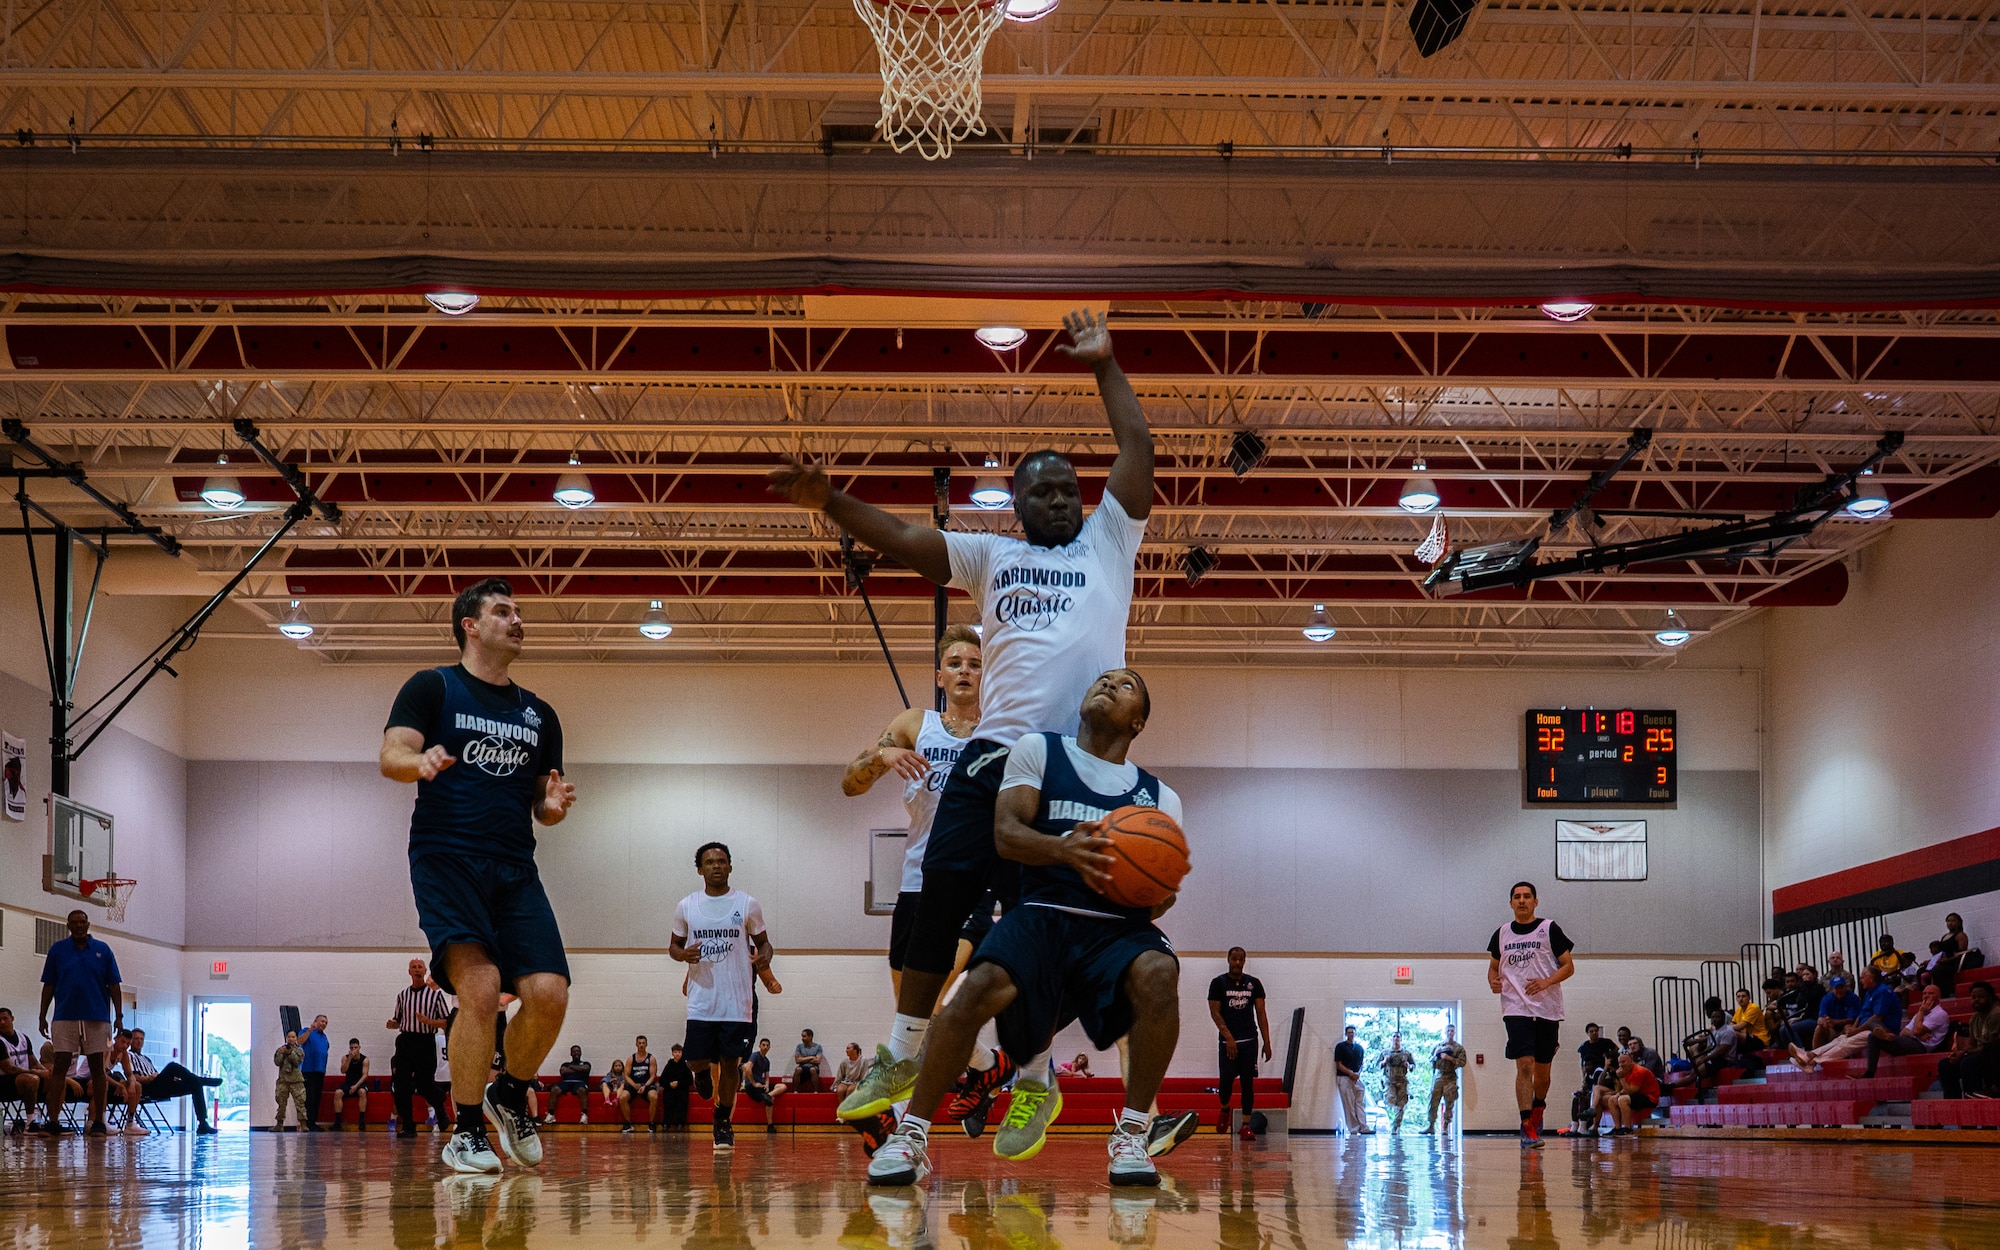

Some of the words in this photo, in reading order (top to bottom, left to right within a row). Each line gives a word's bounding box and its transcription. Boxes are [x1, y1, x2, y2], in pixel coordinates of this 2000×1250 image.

[995, 594, 1075, 623] Classic
[1537, 713, 1561, 725] Home
[1643, 715, 1673, 725] Guests
[455, 713, 538, 747] HARDWOOD
[1538, 728, 1565, 751] 32
[1646, 728, 1674, 752] 25
[462, 740, 530, 765] Classic
[1589, 748, 1618, 760] period
[1623, 745, 1634, 762] 2
[1550, 767, 1555, 782] 1
[1657, 766, 1667, 784] 3
[1537, 787, 1558, 798] fouls
[1591, 786, 1619, 798] player
[1649, 788, 1669, 798] fouls
[699, 942, 734, 958] Classic
[1504, 941, 1541, 951] HARDWOOD
[1508, 952, 1535, 965] Classic
[213, 961, 227, 973] EXIT
[1397, 966, 1410, 977] EXIT
